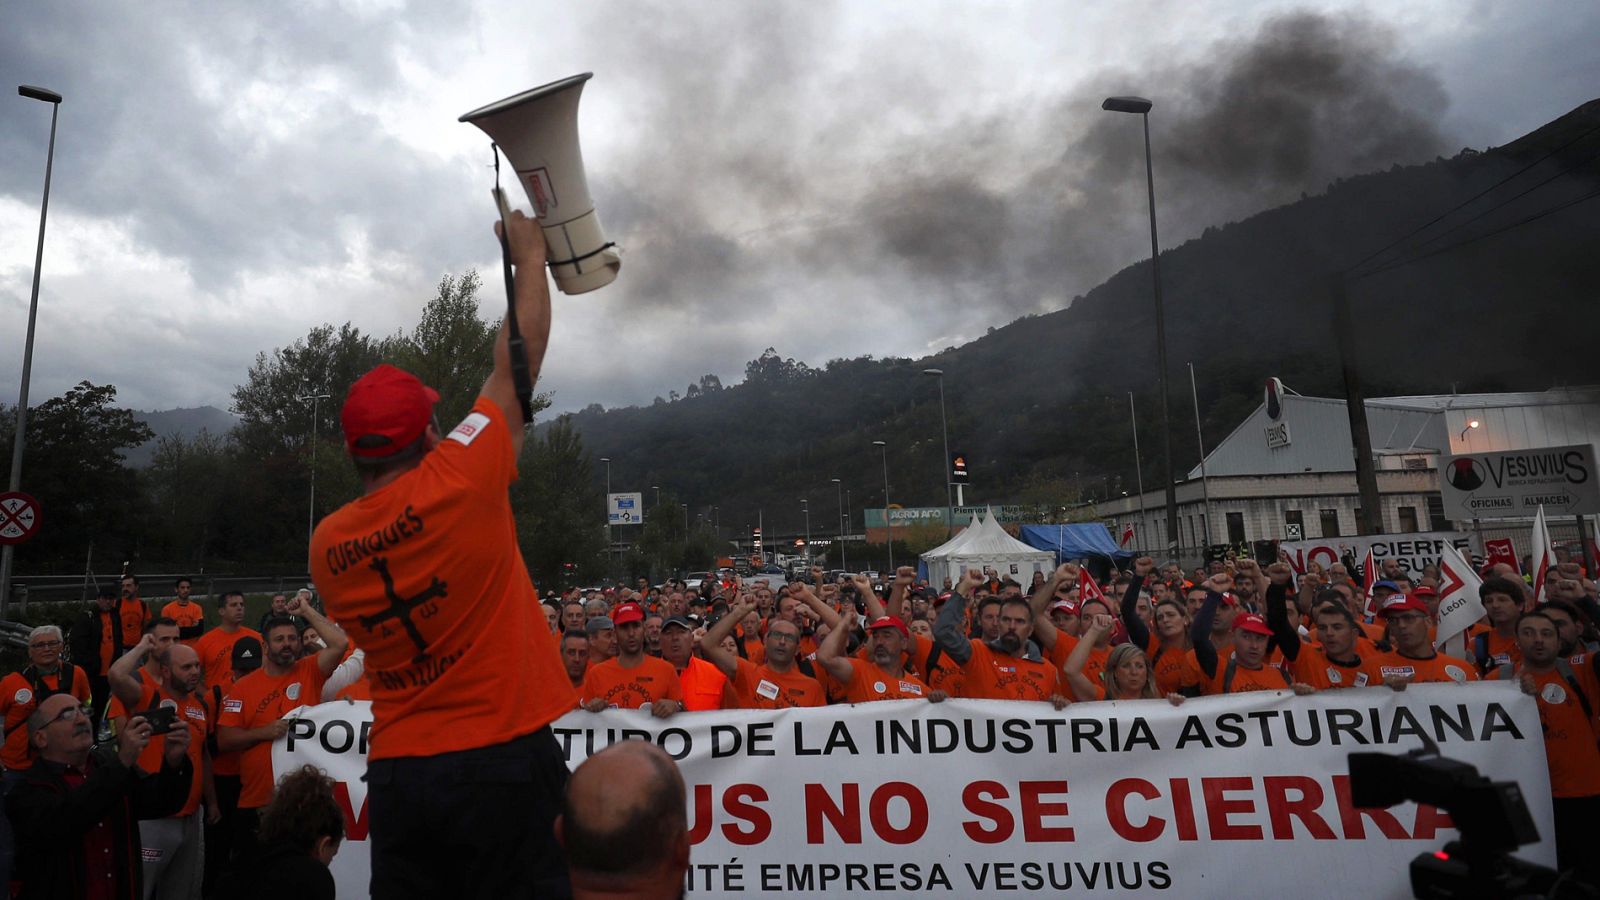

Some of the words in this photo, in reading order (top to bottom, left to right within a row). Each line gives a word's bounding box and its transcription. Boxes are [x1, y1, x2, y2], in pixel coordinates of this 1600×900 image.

[1485, 451, 1588, 488] VESUVIUS
[1470, 497, 1513, 508] OFICINAS
[1524, 495, 1570, 506] ALMACEN
[326, 505, 424, 575] CUENQUES
[1285, 546, 1339, 577] NO
[1440, 598, 1467, 617] León
[711, 722, 776, 758] DE
[794, 721, 859, 755] LA
[876, 717, 1160, 754] INDUSTRIA
[1175, 703, 1525, 749] ASTURIANA
[804, 781, 929, 845] NO
[962, 780, 1075, 844] SE
[688, 857, 744, 891] ITÉ
[760, 863, 953, 891] EMPRESA
[964, 861, 1171, 891] VESUVIUS
